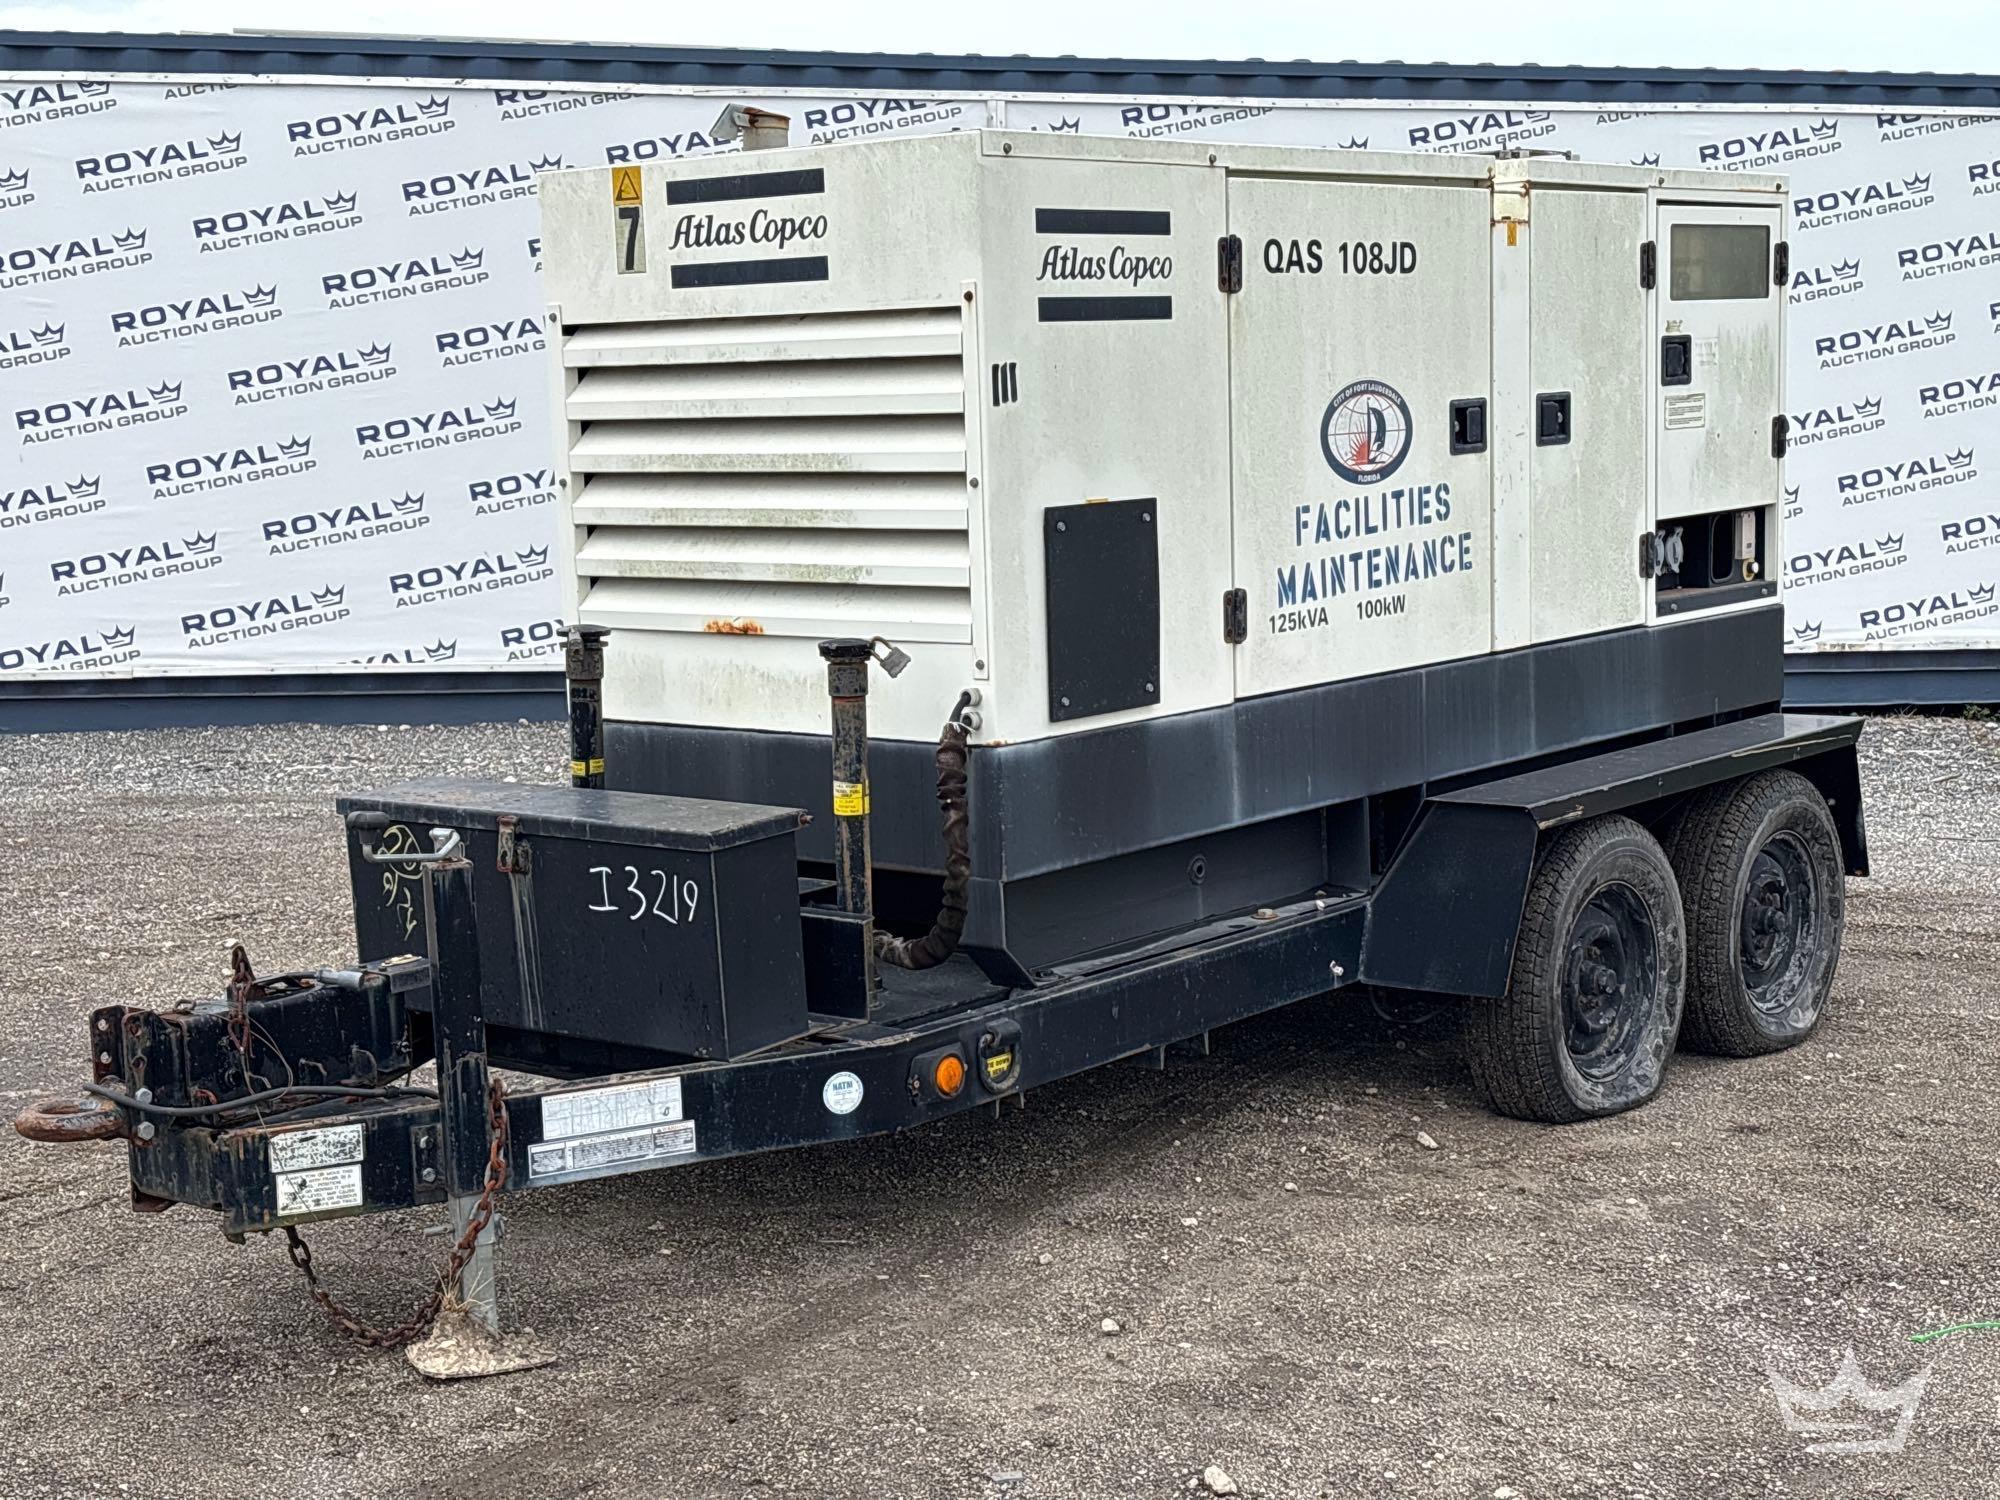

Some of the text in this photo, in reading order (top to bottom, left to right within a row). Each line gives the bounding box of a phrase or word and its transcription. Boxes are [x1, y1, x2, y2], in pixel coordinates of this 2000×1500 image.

[0, 84, 78, 110] YAL
[46, 99, 117, 120] GROUP
[501, 97, 587, 121] AUCTION
[804, 99, 927, 129] ROYAL
[287, 105, 417, 142] ROYAL
[811, 107, 962, 144] AUCTION GROUP
[1211, 107, 1273, 125] GROUP
[1408, 111, 1523, 146] ROYAL
[1495, 124, 1556, 144] GROUP
[1881, 120, 1955, 142] AUCTION
[294, 120, 455, 157] AUCTION GROUP
[1699, 128, 1810, 163] ROYAL
[1782, 141, 1842, 162] GROUP
[75, 141, 208, 178] ROYAL
[82, 156, 248, 194] AUCTION GROUP
[402, 164, 531, 202] ROYAL
[409, 184, 538, 217] AUCTION GRO
[1794, 181, 1903, 217] ROYAL
[192, 200, 325, 238] ROYAL
[669, 209, 827, 250] Atlas Copco
[1798, 195, 1934, 231] AUCTION GROUP
[200, 216, 363, 253] AUCTION GROUP
[618, 207, 640, 270] 7
[0, 252, 153, 289] UCTION GROUP
[1037, 245, 1173, 287] Atlas Copco
[1264, 238, 1417, 275] QAS 108JD
[1903, 258, 1976, 281] AUCTION
[322, 256, 452, 295] ROYAL
[328, 272, 490, 309] AUCTION GROUP
[1805, 281, 1863, 301] GROUP
[111, 294, 244, 332] ROYAL
[118, 309, 283, 348] AUCTION GROUP
[435, 315, 545, 352] ROYA
[1815, 320, 1925, 356] ROYAL
[1820, 333, 1955, 370] AUCTION GROUP
[0, 347, 71, 369] GROUP
[228, 352, 359, 390] ROYAL
[442, 342, 528, 368] AUCTION
[234, 367, 397, 406] AUCTION GROUP
[1333, 393, 1346, 407] CITY
[1353, 383, 1367, 393] FORT
[1368, 383, 1402, 405] LAUDERDALE
[1919, 373, 2000, 405] ROYA
[15, 391, 149, 429] ROYAL
[22, 405, 189, 445] AUCTION GROUP
[1789, 406, 1854, 430] YAL
[1923, 395, 1997, 419] AUCTION
[356, 407, 485, 445] ROYAL
[363, 421, 522, 460] AUCTION GROUP
[1827, 419, 1885, 440] GROUP
[146, 446, 279, 484] ROYAL
[153, 460, 317, 500] AUCTION GROUP
[1357, 473, 1381, 483] FLORIDA
[1838, 457, 1946, 493] ROYAL
[0, 485, 67, 512] YAL
[469, 469, 556, 501] ROY
[1842, 470, 1978, 507] AUCTION GROUP
[35, 500, 106, 521] GROUP
[262, 502, 392, 541] ROYAL
[1295, 483, 1451, 546] FACILITIES
[1941, 514, 2000, 541] ROY
[269, 516, 430, 556] AUCTION GROUP
[50, 541, 184, 581] ROYAL
[57, 556, 223, 597] AUCTION GROUP
[389, 555, 517, 593] ROYAL
[1277, 532, 1473, 608] MAINTENANCE
[1784, 542, 1876, 575] OYAL
[1784, 555, 1908, 590] UCTION GROUP
[396, 568, 554, 608] AUCTION GROUP
[181, 594, 312, 634] ROYAL
[188, 609, 350, 649] AUCTION GROUP
[1269, 594, 1406, 634] 125kVA 100kW
[1860, 592, 1968, 629] ROYAL
[1864, 605, 1999, 641] AUCTION GROUP
[0, 635, 102, 670] OYAL
[70, 650, 141, 670] GROUP
